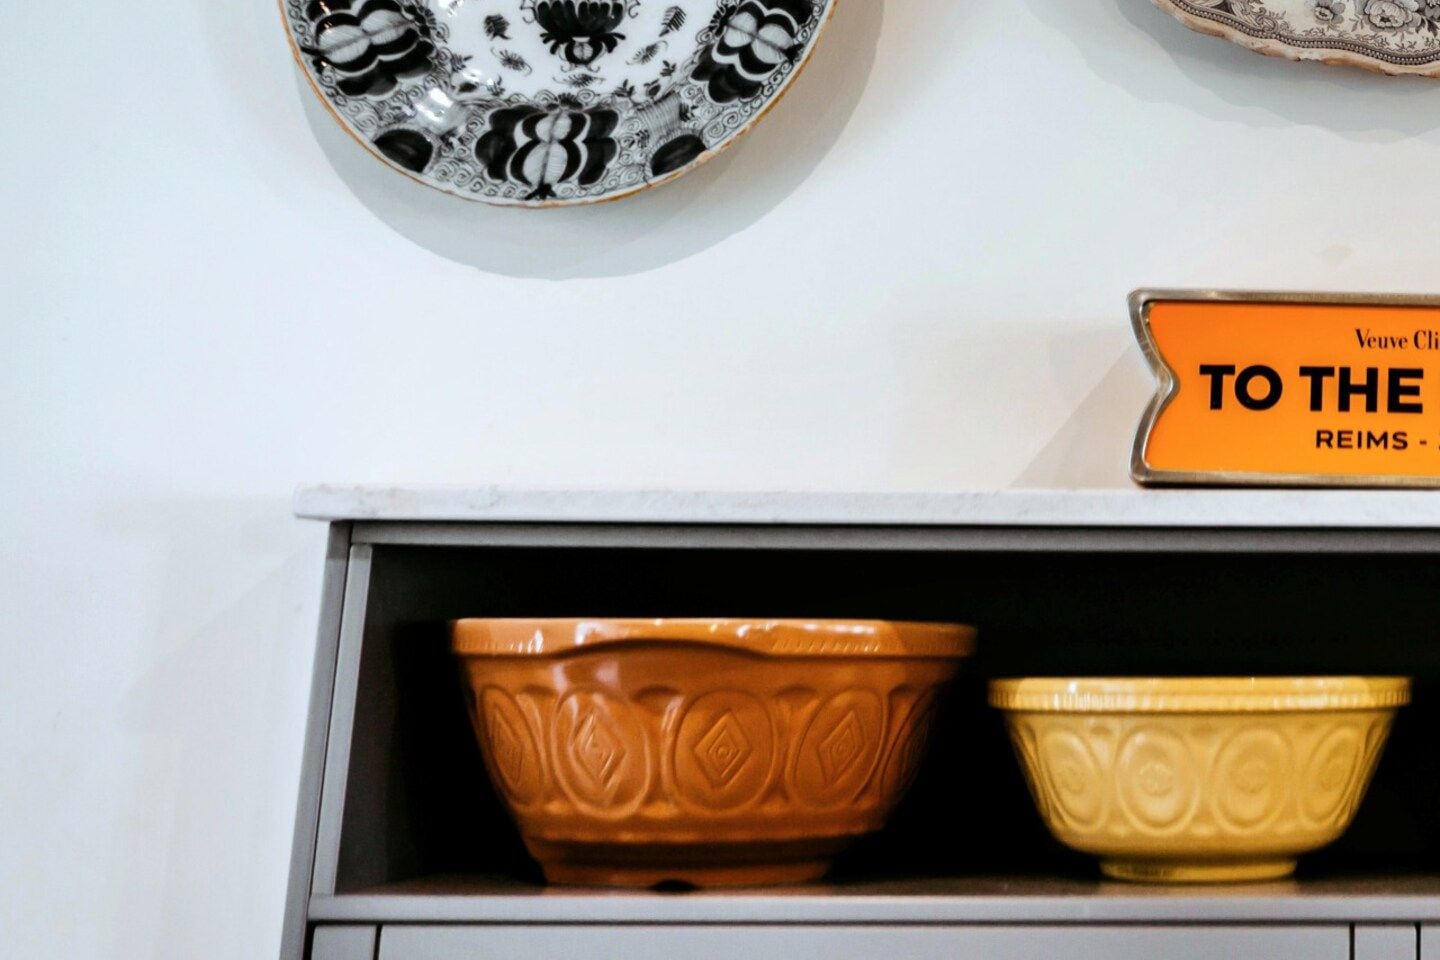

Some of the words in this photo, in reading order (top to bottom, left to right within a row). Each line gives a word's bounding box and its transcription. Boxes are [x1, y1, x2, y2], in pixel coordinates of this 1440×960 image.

[1355, 328, 1408, 349] Veuve
[1199, 364, 1284, 411] TO
[1299, 366, 1425, 415] THE
[1315, 429, 1409, 451] REIMS
